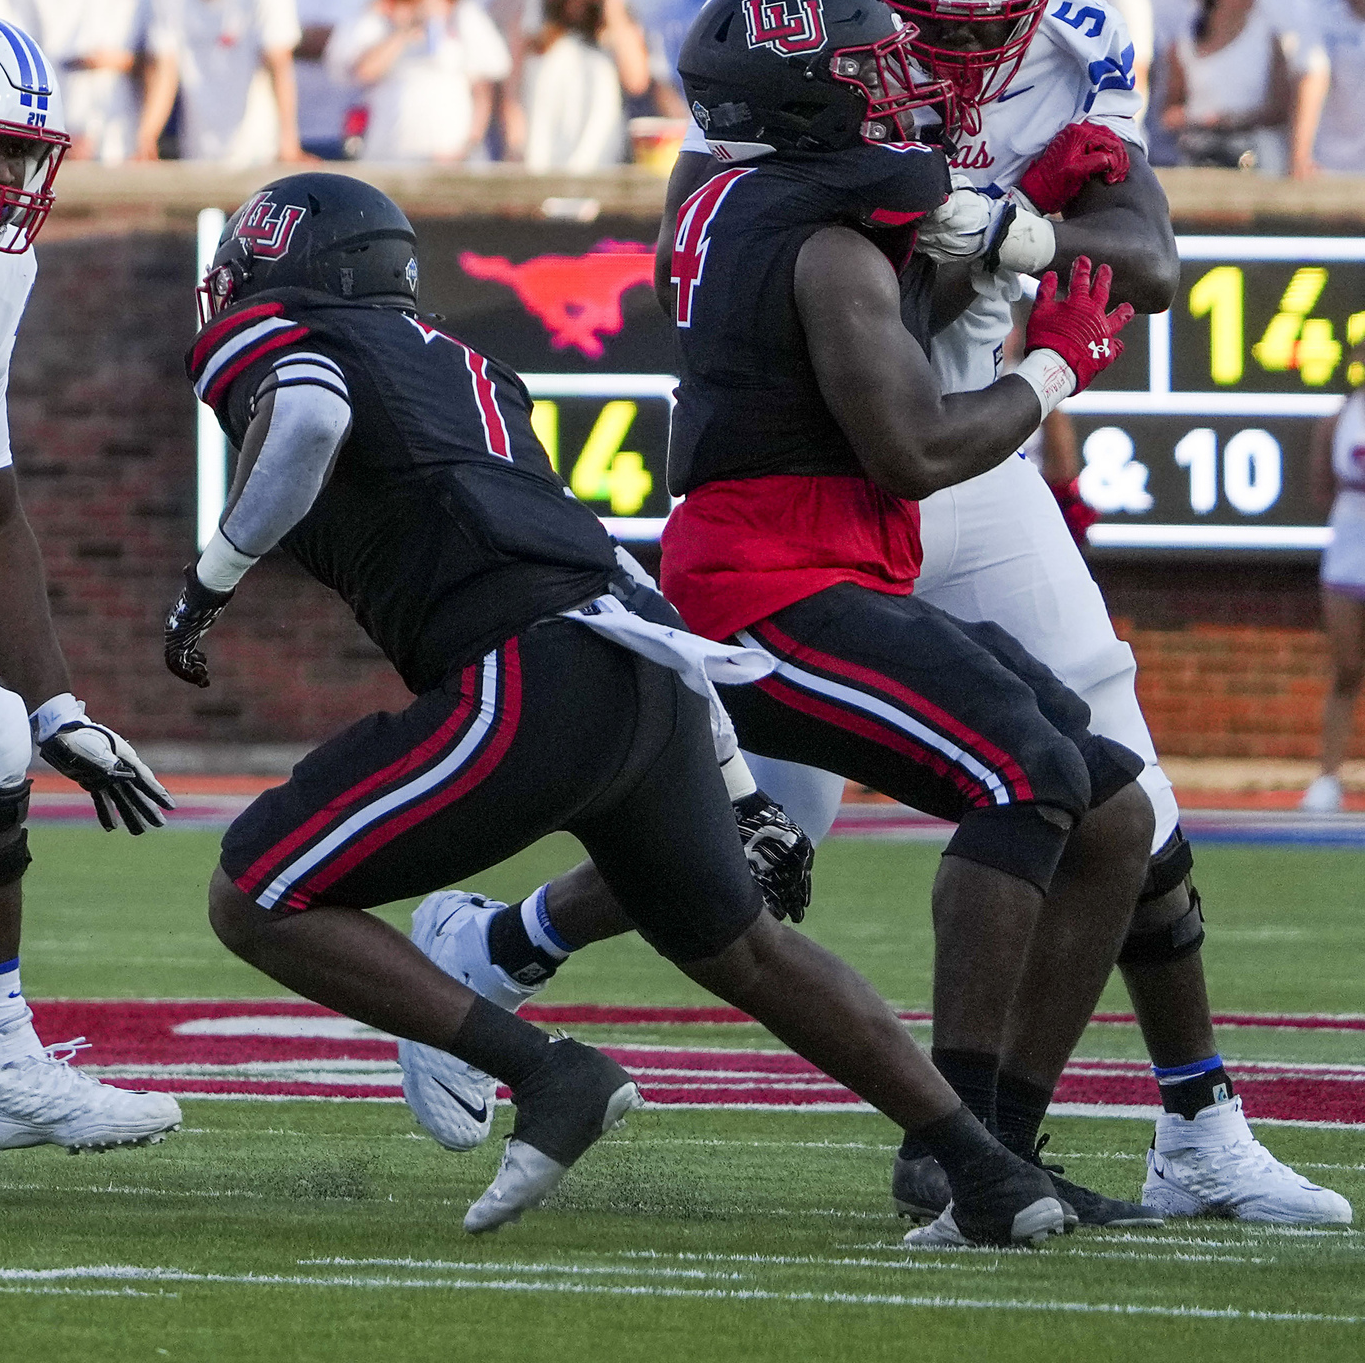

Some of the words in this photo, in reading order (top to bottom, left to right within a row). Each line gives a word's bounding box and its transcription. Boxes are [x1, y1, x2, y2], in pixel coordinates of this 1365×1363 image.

[27, 111, 48, 128] 214
[230, 190, 307, 262] LU
[670, 166, 759, 329] 4
[1077, 426, 1154, 514] &
[1174, 427, 1282, 517] 10
